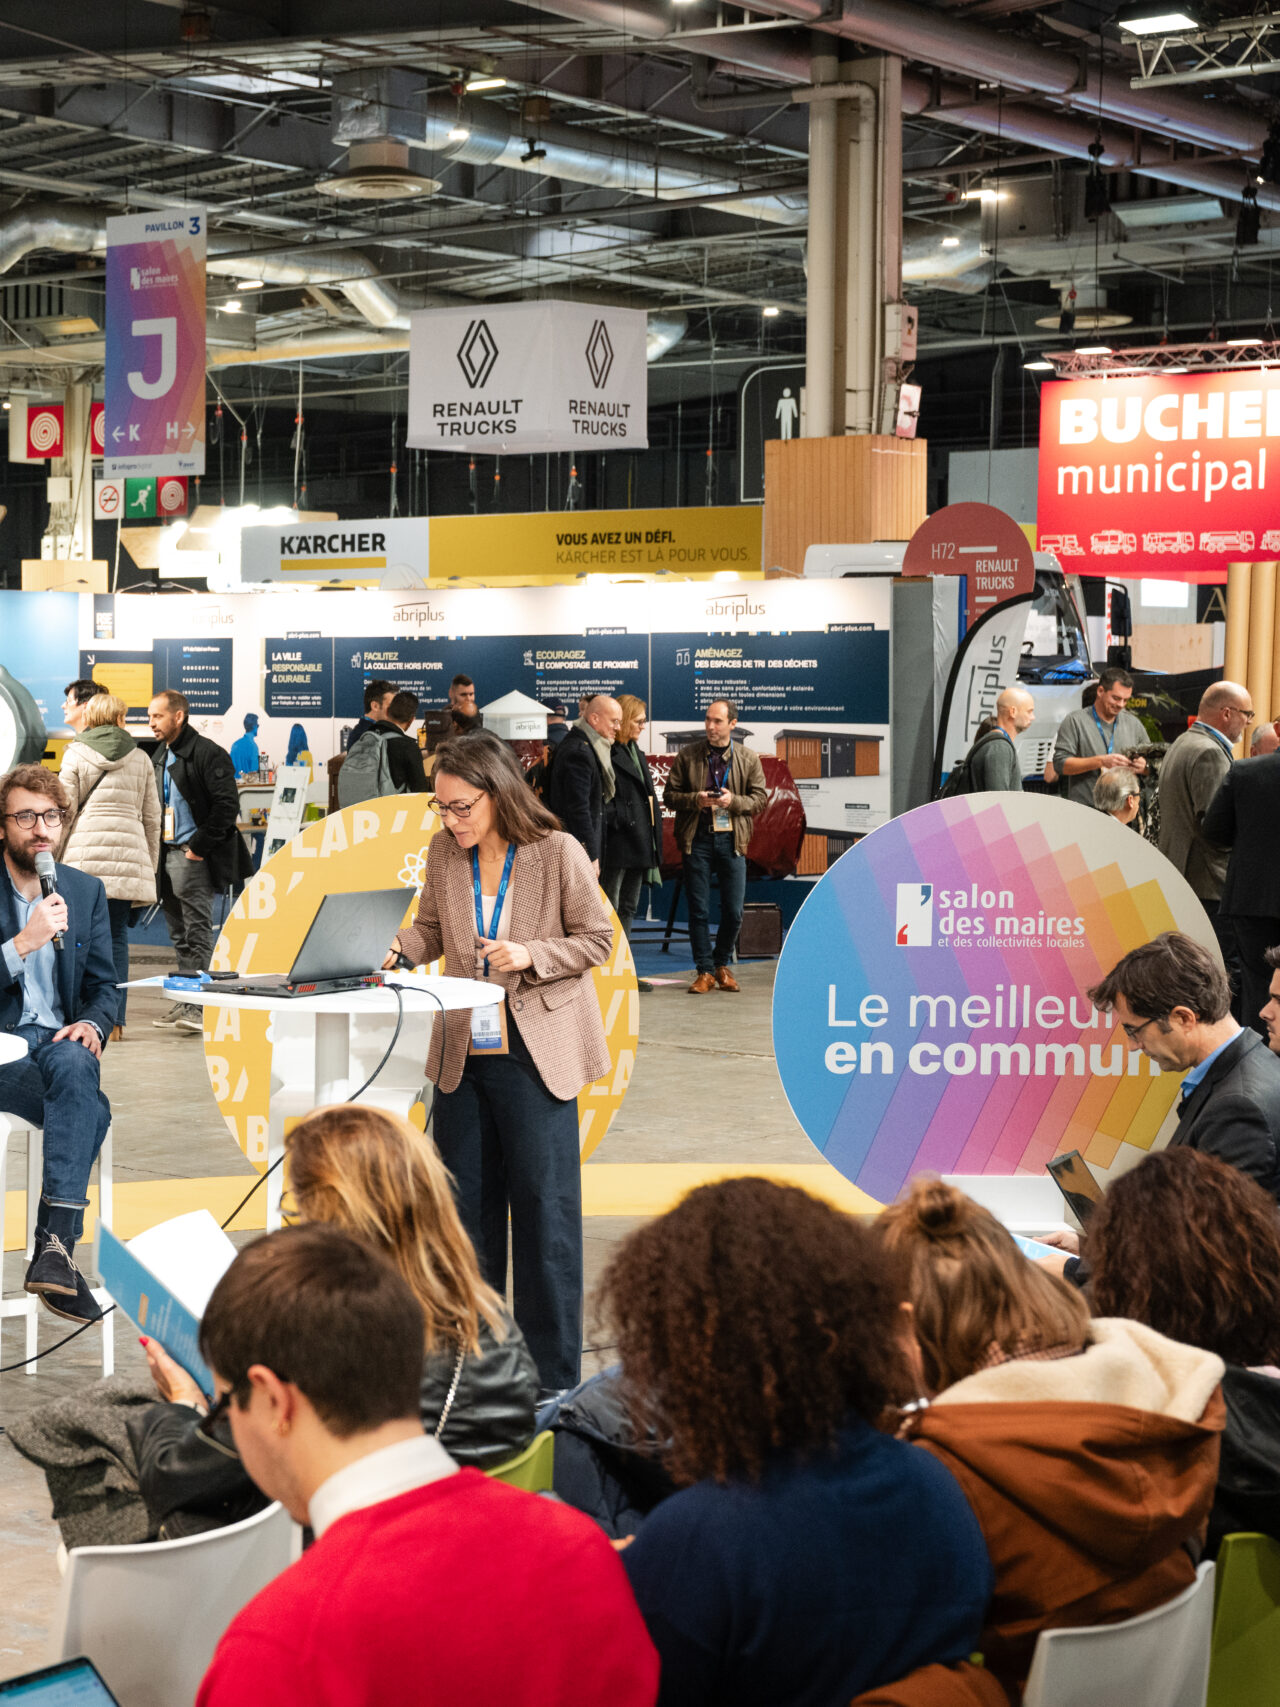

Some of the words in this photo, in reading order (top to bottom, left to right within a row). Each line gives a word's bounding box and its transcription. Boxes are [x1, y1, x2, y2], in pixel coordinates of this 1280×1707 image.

[145, 221, 184, 232] PAVILLON
[189, 216, 200, 235] 3
[127, 317, 177, 400] J
[432, 399, 523, 418] RENAULT
[569, 399, 630, 418] RENAULT
[129, 424, 140, 442] K
[166, 422, 178, 439] H
[437, 419, 517, 436] TRUCKS
[572, 419, 627, 437] TRUCKS
[1057, 447, 1267, 502] municipal
[281, 533, 386, 554] KÄRCHER
[556, 533, 588, 545] VOUS
[590, 532, 621, 545] AVEZ
[625, 531, 642, 544] UN
[645, 529, 676, 543] DÉFI.
[620, 549, 643, 563] EST
[648, 547, 664, 563] LÀ
[669, 548, 706, 562] POUR
[710, 547, 750, 562] VOUS.
[931, 543, 955, 559] H72
[976, 558, 1019, 573] RENAULT
[976, 576, 1015, 590] TRUCKS
[393, 605, 445, 628] abriplus
[705, 598, 766, 622] abriplus
[272, 652, 282, 661] LA
[282, 652, 302, 661] VILLE
[364, 652, 399, 661] FACILITEZ
[536, 650, 586, 660] ECOURAGEZ
[694, 647, 743, 658] AMÉNAGEZ
[272, 663, 322, 672] RESPONSABLE
[364, 662, 373, 670] LA
[373, 662, 403, 670] COLLECTE
[404, 662, 422, 670] HORS
[422, 662, 443, 670] FOYER
[536, 661, 545, 669] LE
[545, 661, 591, 669] COMPOSTAGE
[592, 661, 603, 669] DE
[603, 659, 639, 669] PROXIMITÉ
[694, 660, 709, 668] DES
[709, 660, 741, 668] ESPACES
[741, 660, 753, 668] DE
[753, 660, 766, 668] TRI
[768, 660, 783, 668] DES
[783, 659, 818, 668] DÉCHETS
[272, 674, 278, 683] &
[278, 674, 311, 683] DURABLE
[970, 634, 1007, 725] briplus
[939, 883, 1014, 909] salon
[939, 910, 985, 935] des
[995, 910, 1085, 935] maires
[938, 937, 949, 948] et
[953, 936, 973, 948] des
[976, 935, 1042, 948] collectivités
[1046, 936, 1085, 948] locales
[828, 984, 889, 1027] Le
[824, 1041, 894, 1075] en
[908, 1041, 1162, 1077] commun
